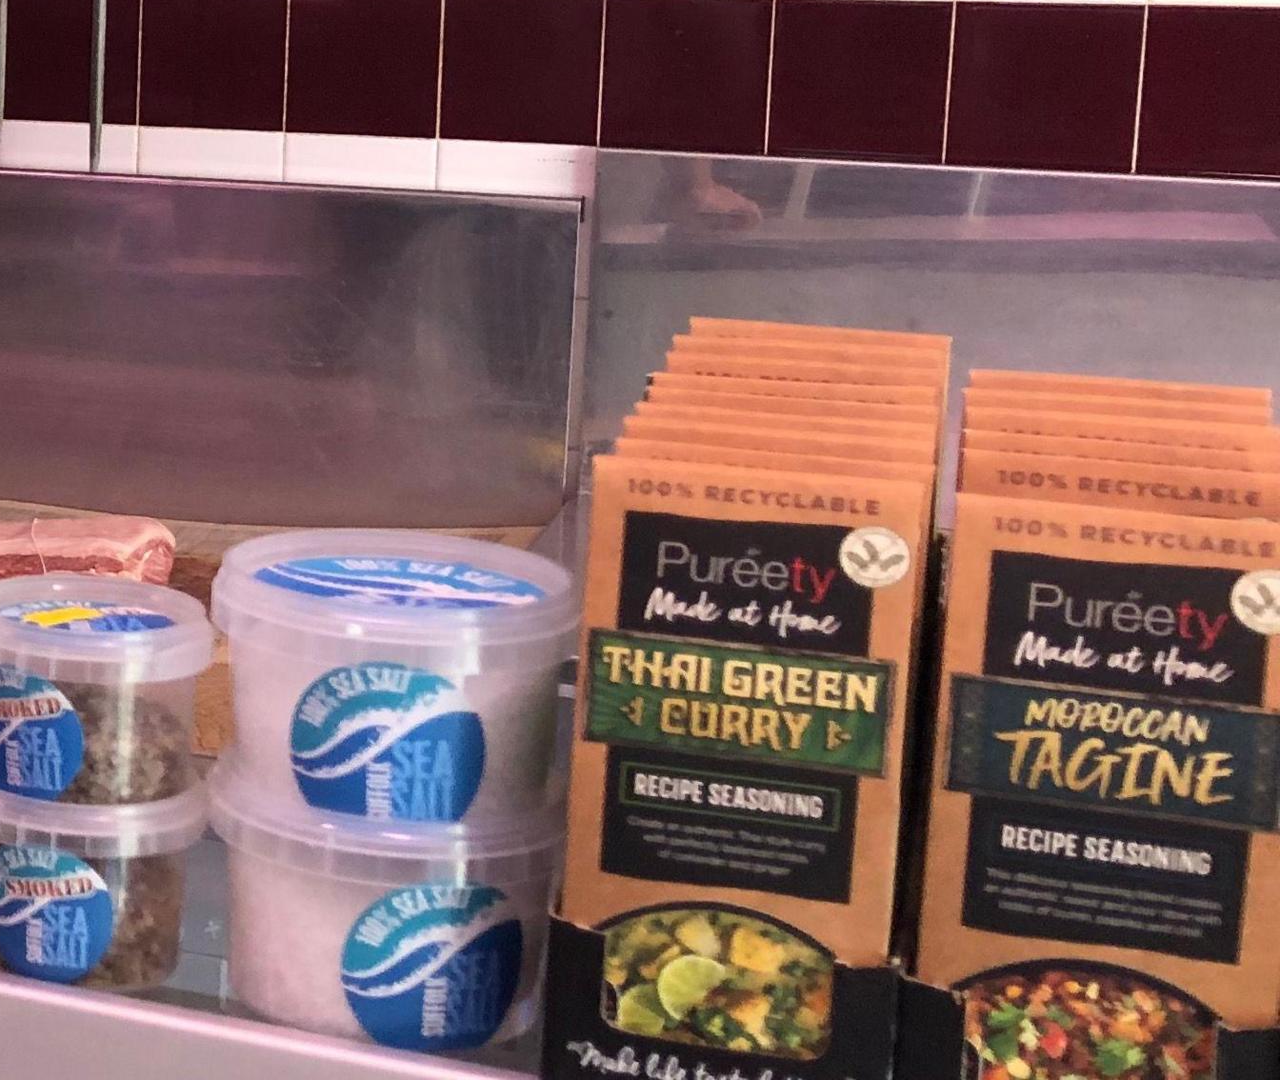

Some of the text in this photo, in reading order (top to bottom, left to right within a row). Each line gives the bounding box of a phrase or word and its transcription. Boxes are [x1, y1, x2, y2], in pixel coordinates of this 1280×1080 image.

[627, 478, 881, 516] 100% RECYCLABLE
[996, 470, 1262, 507] 100% RECYCLABLE
[994, 517, 1276, 559] 100% RECYCLABLE
[644, 586, 842, 637] Made at Home
[602, 646, 878, 713] THAI GREEN
[1013, 630, 1236, 686] Made at Home
[19, 726, 61, 758] SEA
[660, 696, 813, 751] CURRY
[1024, 698, 1212, 746] MOROCCAN
[20, 756, 63, 791] SALT
[392, 739, 454, 777] SEA
[993, 730, 1235, 806] TAGINE
[392, 776, 454, 821] SALT
[633, 772, 824, 820] RECIPE SEASONING
[1001, 823, 1213, 876] RECIPE SEASONING
[5, 878, 93, 897] SMOKED
[43, 904, 88, 935] SEA
[43, 933, 89, 969] SALT
